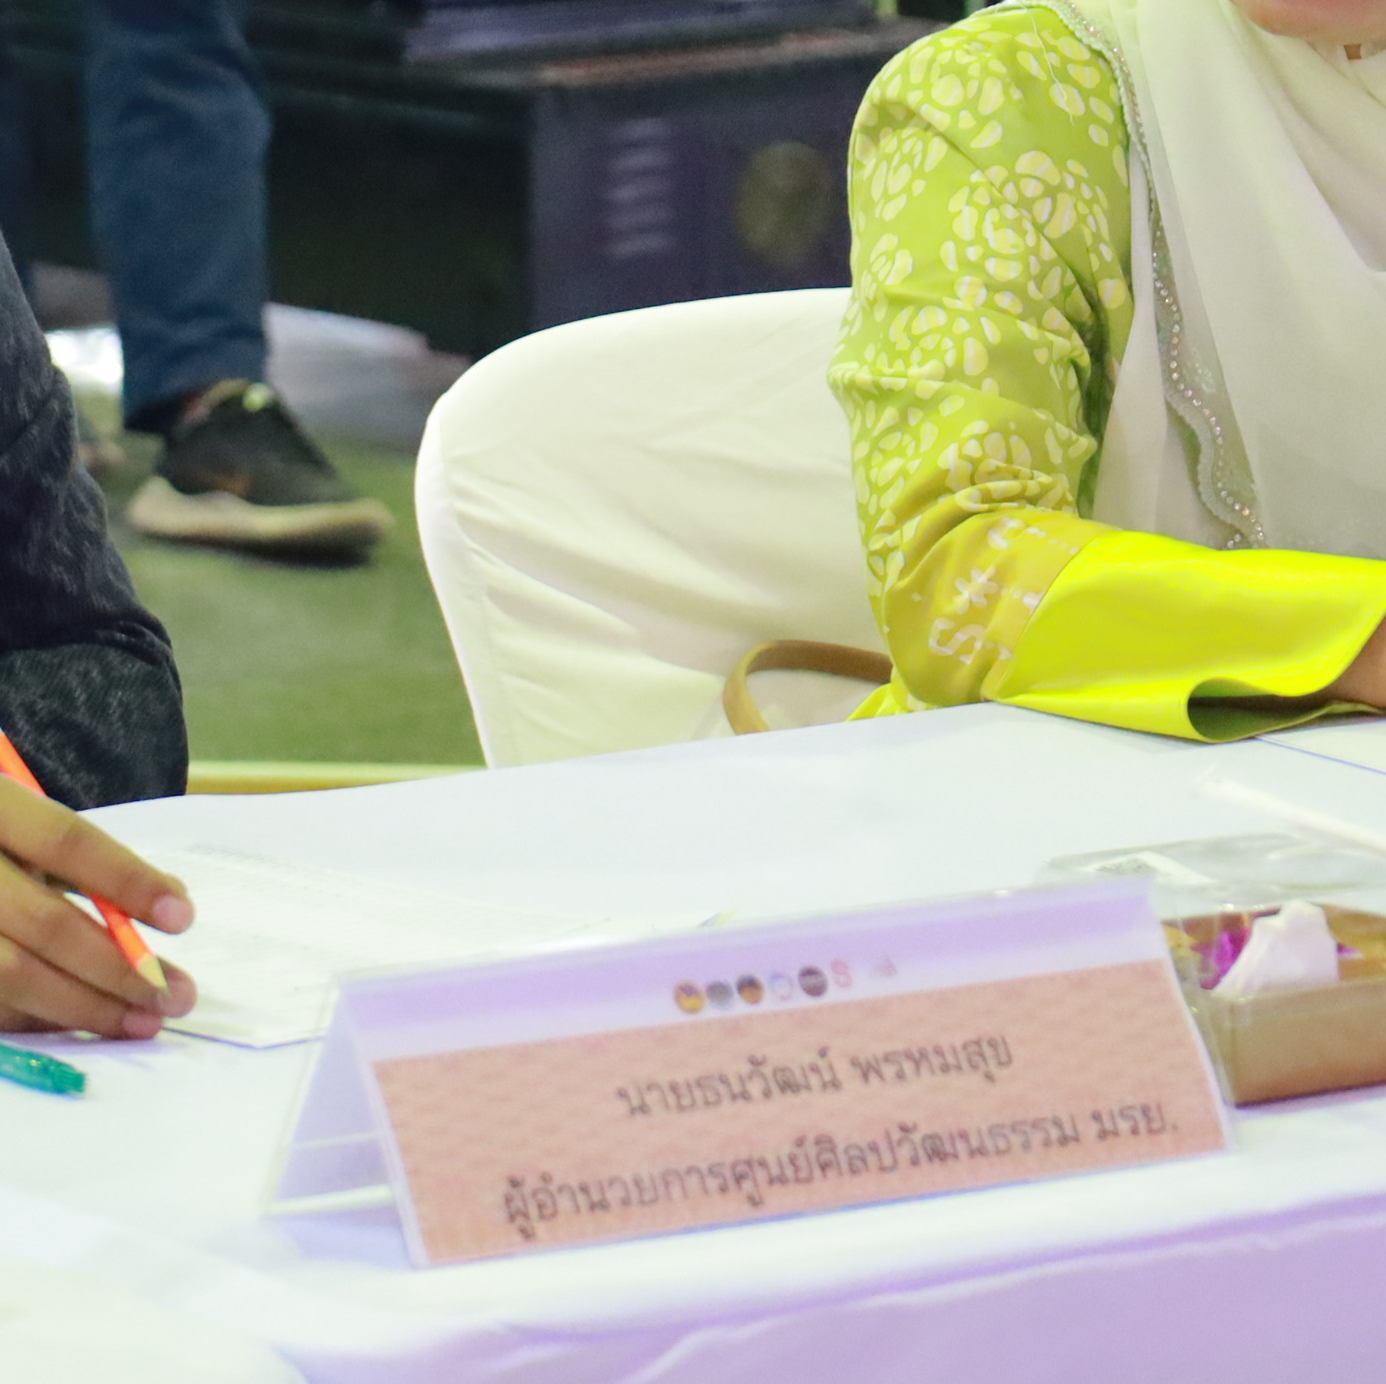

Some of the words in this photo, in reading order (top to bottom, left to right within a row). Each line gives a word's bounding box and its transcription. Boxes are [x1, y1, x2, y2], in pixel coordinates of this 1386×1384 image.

[617, 1046, 841, 1116] นายธนวัฒน์
[1091, 1102, 1179, 1141] มรย.
